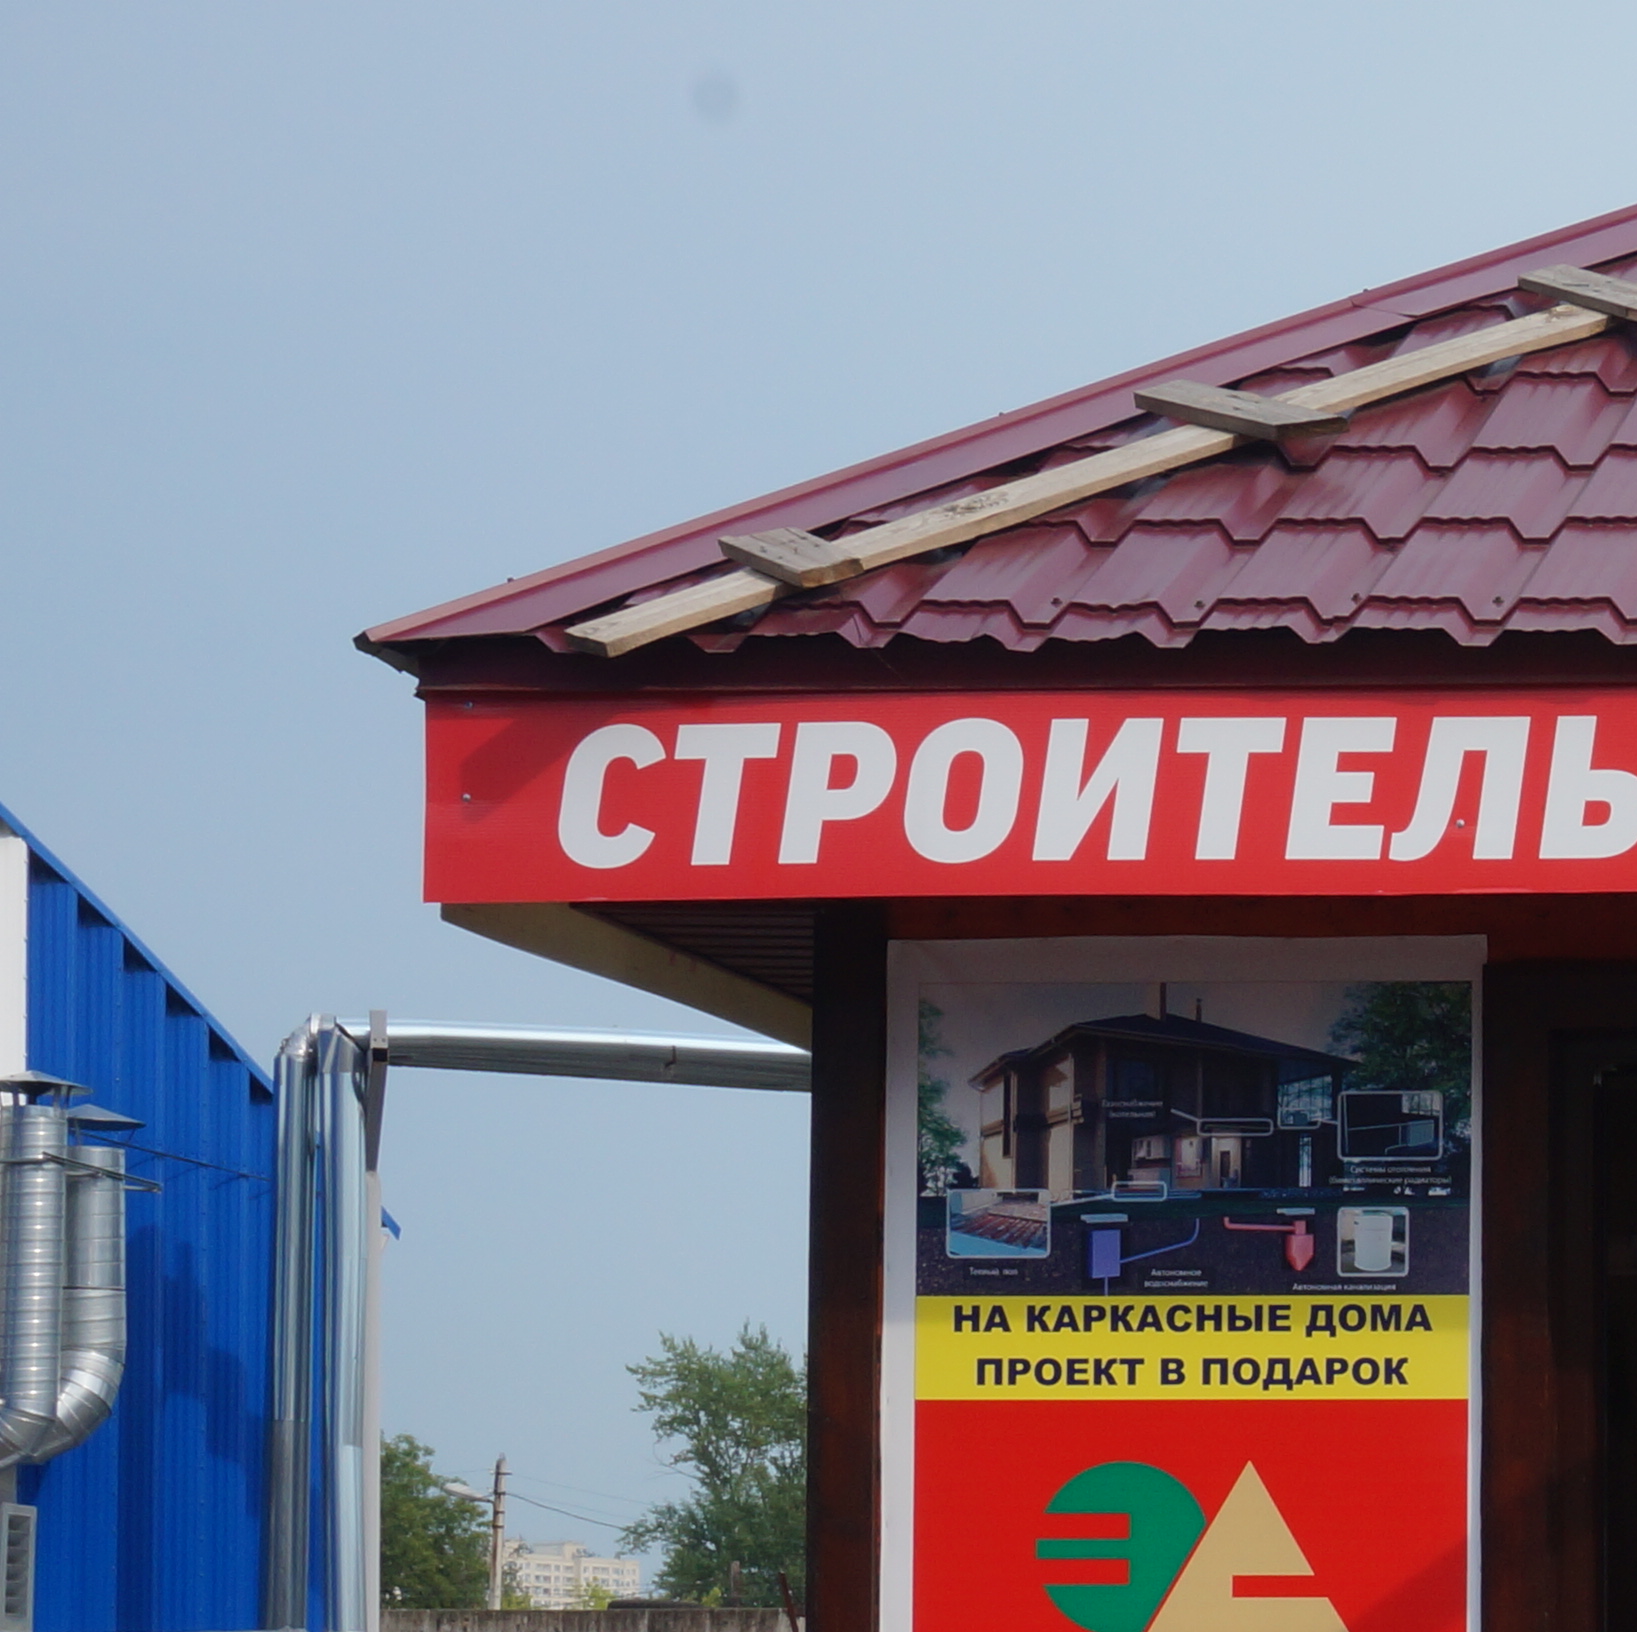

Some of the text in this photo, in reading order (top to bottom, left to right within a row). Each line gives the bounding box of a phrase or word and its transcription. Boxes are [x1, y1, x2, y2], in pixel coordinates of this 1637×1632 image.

[954, 1304, 1432, 1337] НА КАРКАСНЫЕ ДОМА
[977, 1358, 1408, 1390] ПРОЕКТ В ПОДАРОК
